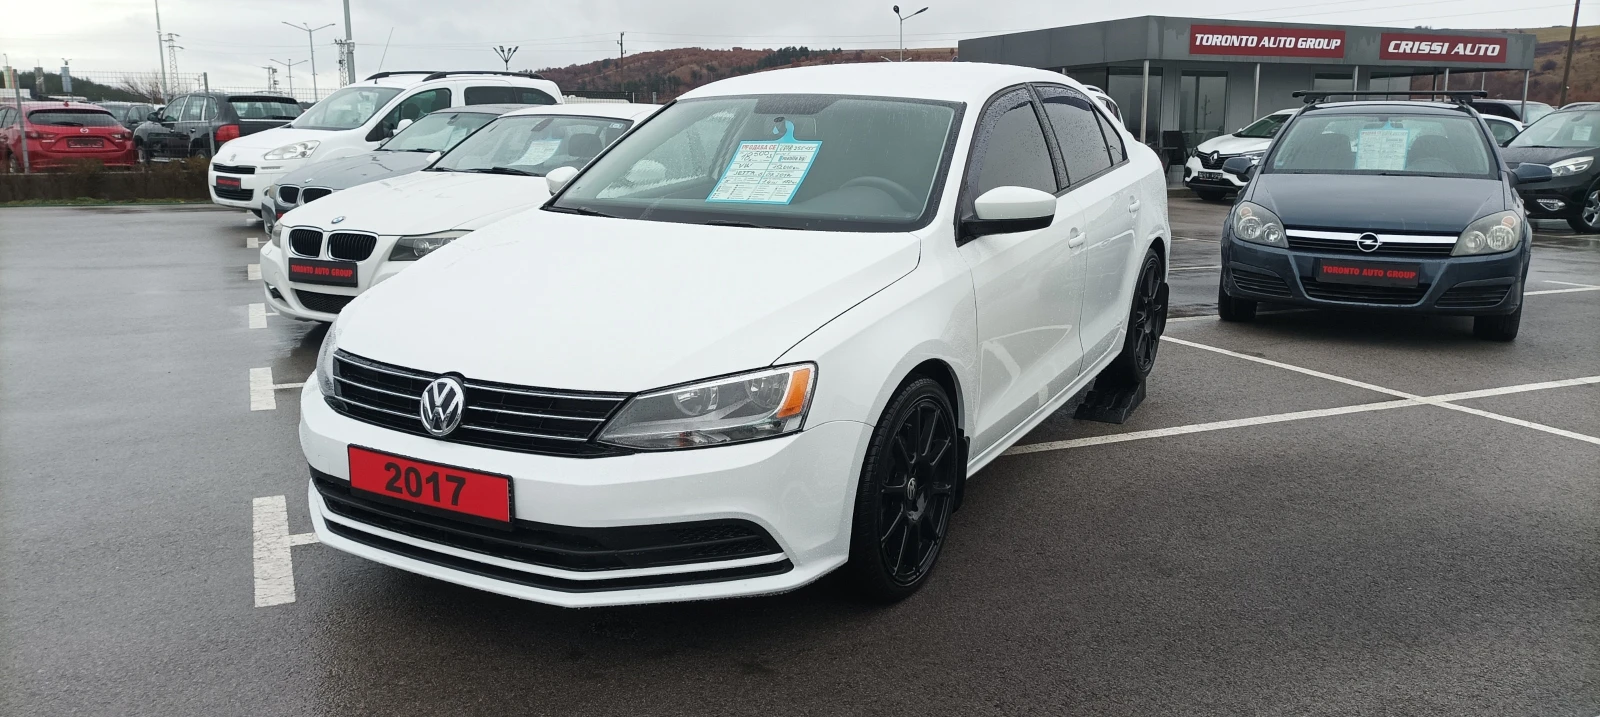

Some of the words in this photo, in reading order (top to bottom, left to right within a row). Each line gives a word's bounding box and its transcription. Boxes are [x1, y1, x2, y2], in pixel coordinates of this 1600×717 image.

[1195, 33, 1258, 47] TORONTO
[1258, 36, 1295, 48] AUTO
[1297, 37, 1341, 50] GROUP
[1388, 40, 1450, 55] CRISSI
[1450, 43, 1500, 56] AUTO
[291, 264, 314, 274] TORONTO
[315, 266, 330, 276] AUTO
[331, 268, 353, 278] GROUP
[1323, 265, 1360, 276] TORONTO
[1362, 268, 1384, 277] AUTO
[1386, 270, 1416, 279] GROUP
[420, 377, 465, 437] VW
[384, 461, 466, 506] 2017
